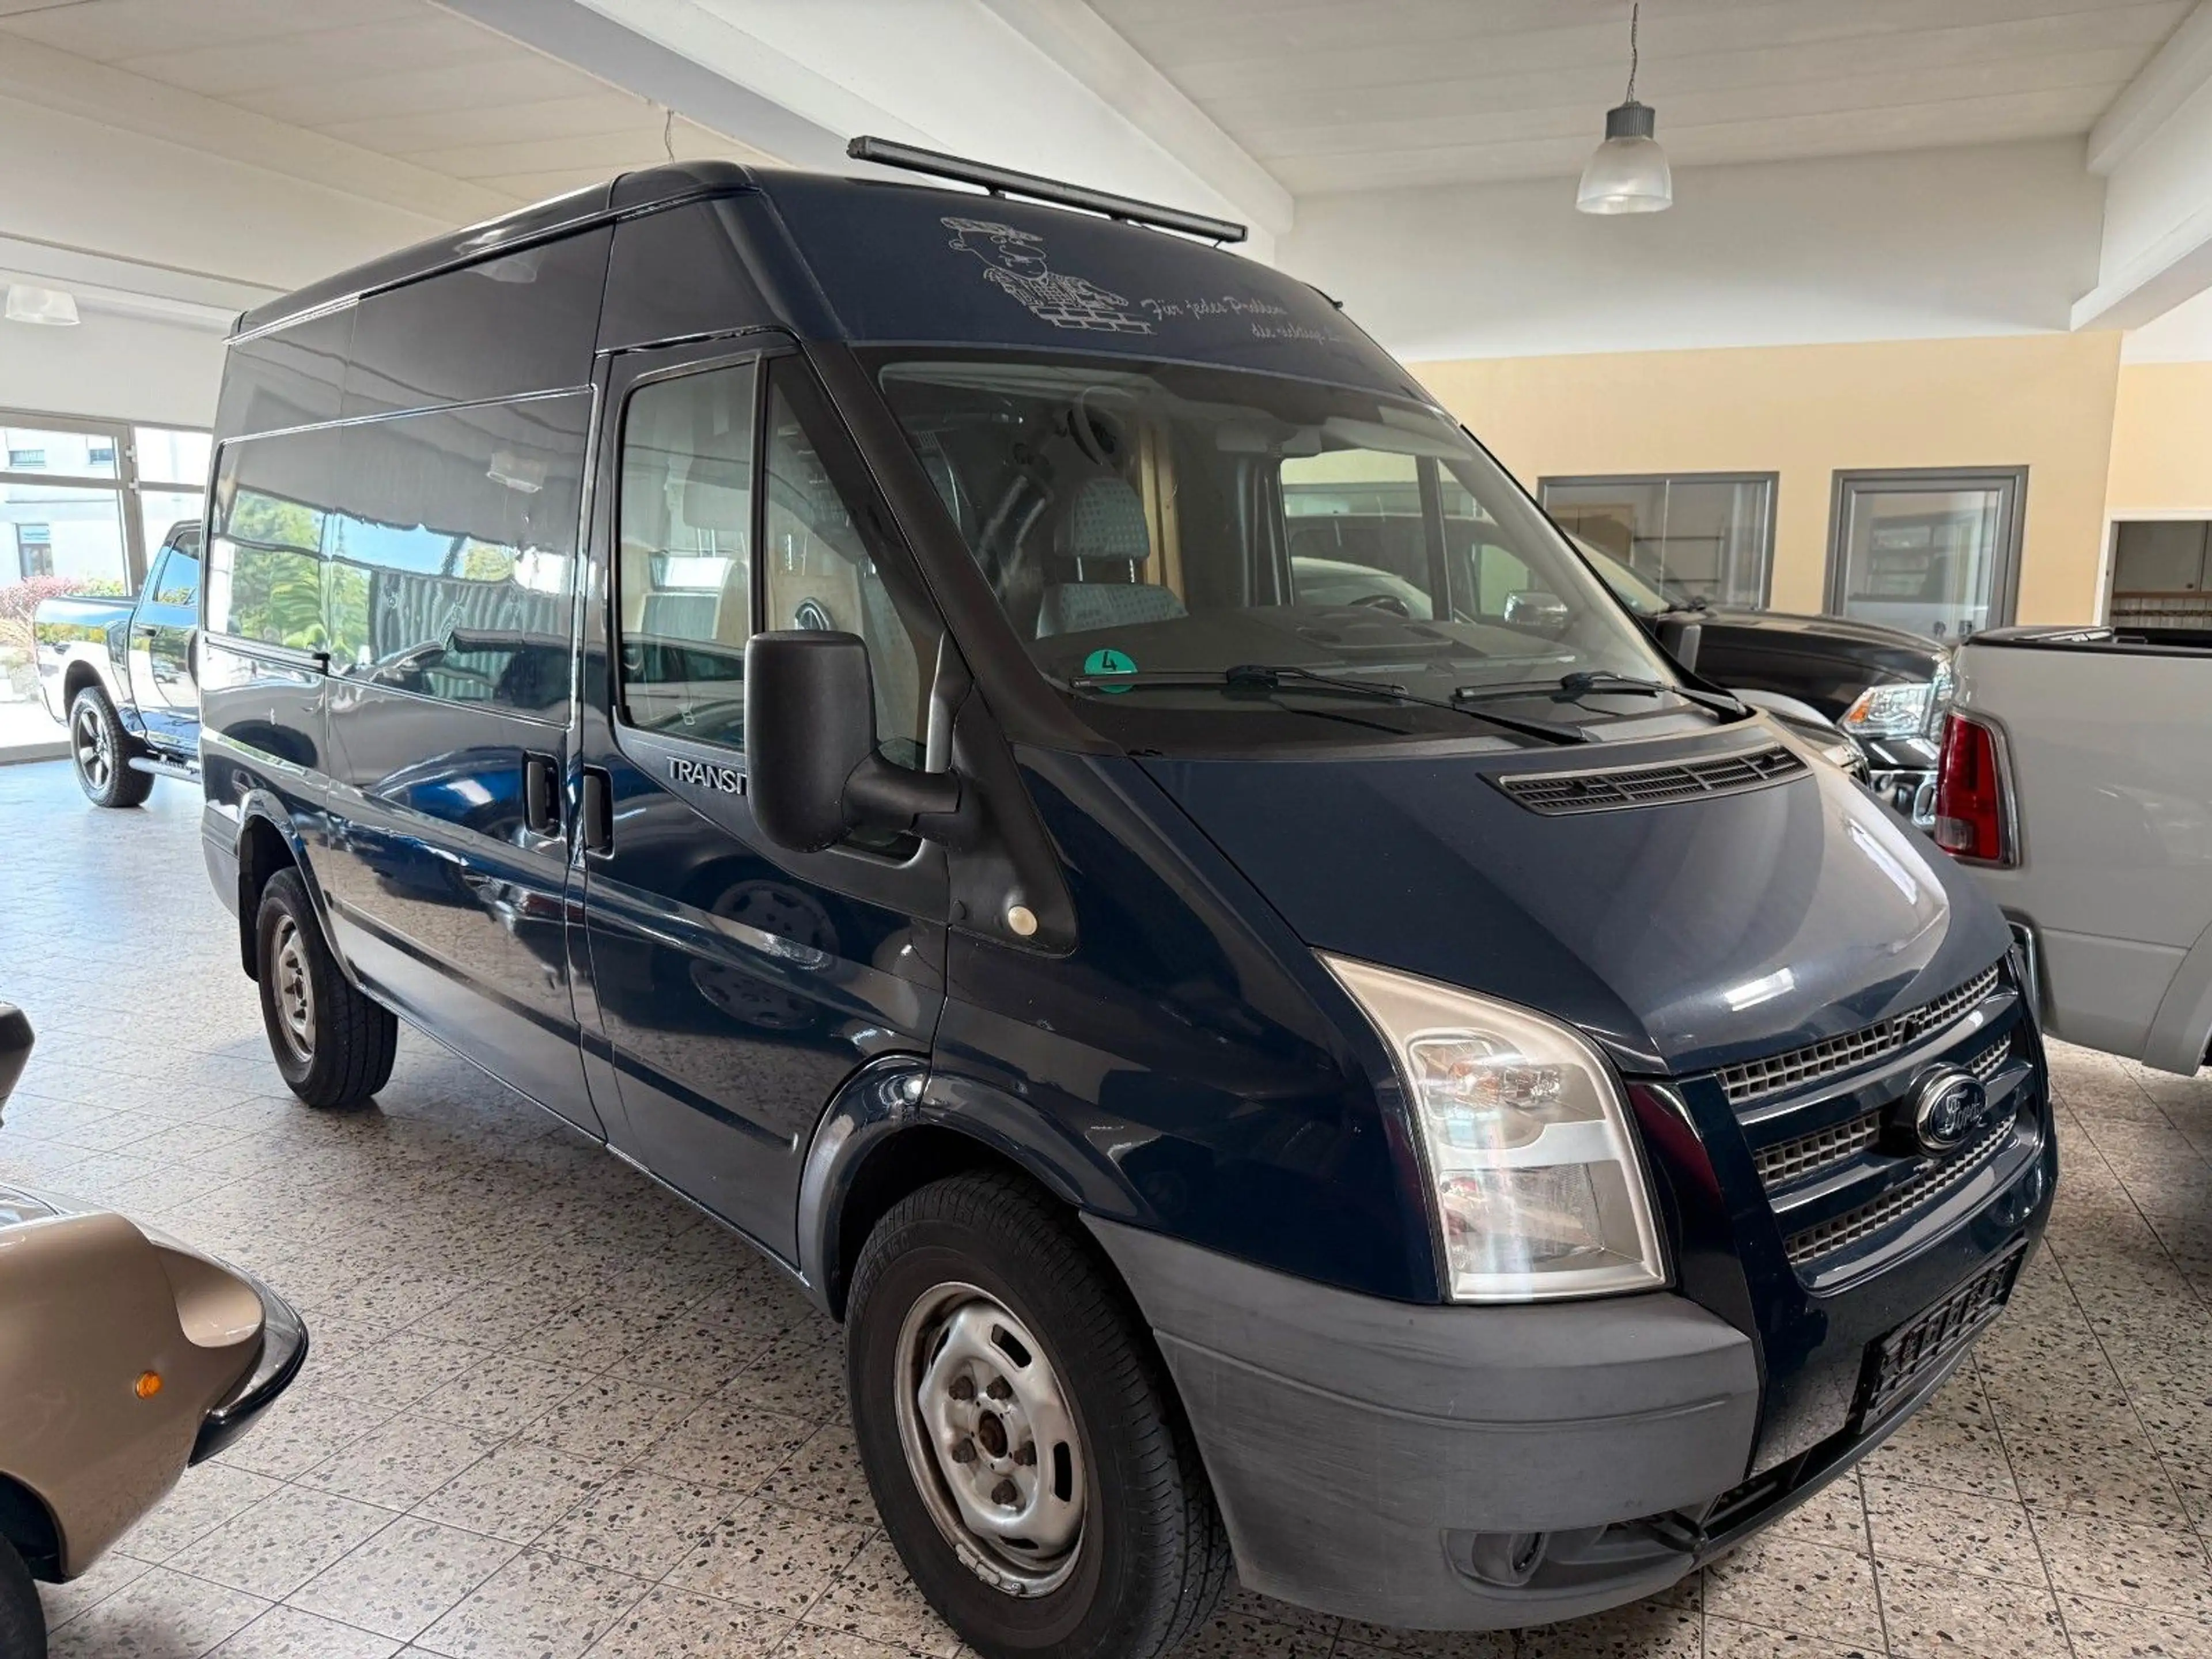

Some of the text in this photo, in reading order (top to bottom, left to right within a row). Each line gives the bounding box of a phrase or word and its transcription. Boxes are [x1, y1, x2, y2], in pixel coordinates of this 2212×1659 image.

[1139, 298, 1183, 321] Für
[1184, 297, 1228, 320] jedes
[1103, 651, 1118, 670] 4
[1937, 1088, 1987, 1135] Ford
